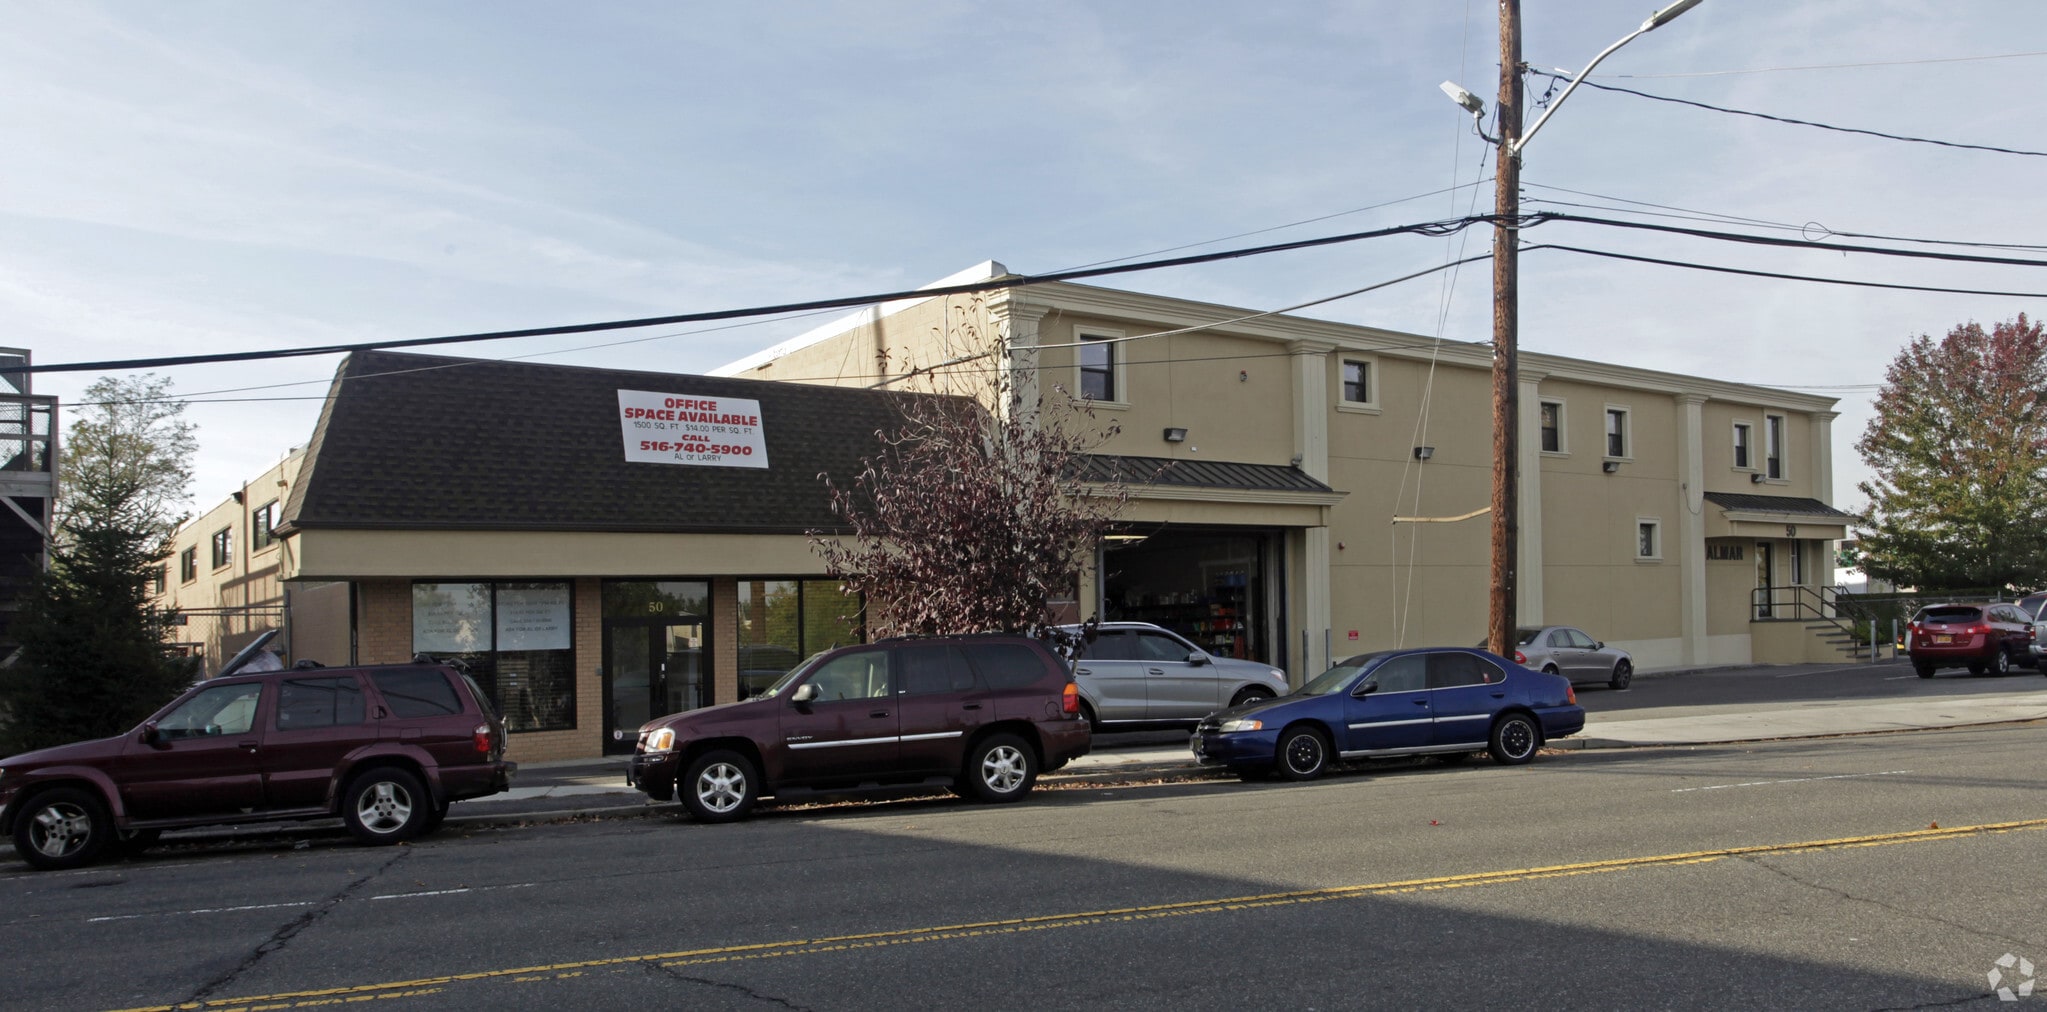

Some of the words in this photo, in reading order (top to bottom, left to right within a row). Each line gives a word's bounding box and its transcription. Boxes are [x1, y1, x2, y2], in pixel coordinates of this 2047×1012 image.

[665, 398, 717, 411] OFFICE
[625, 408, 675, 421] SPACE
[678, 411, 758, 426] AVAILABLE
[633, 421, 652, 429] 1500
[685, 424, 710, 432] $14.00
[682, 434, 711, 442] CALL
[640, 441, 753, 456] 516-740-5900
[698, 454, 722, 462] LARRY
[1786, 522, 1796, 537] 50
[649, 601, 664, 613] 50
